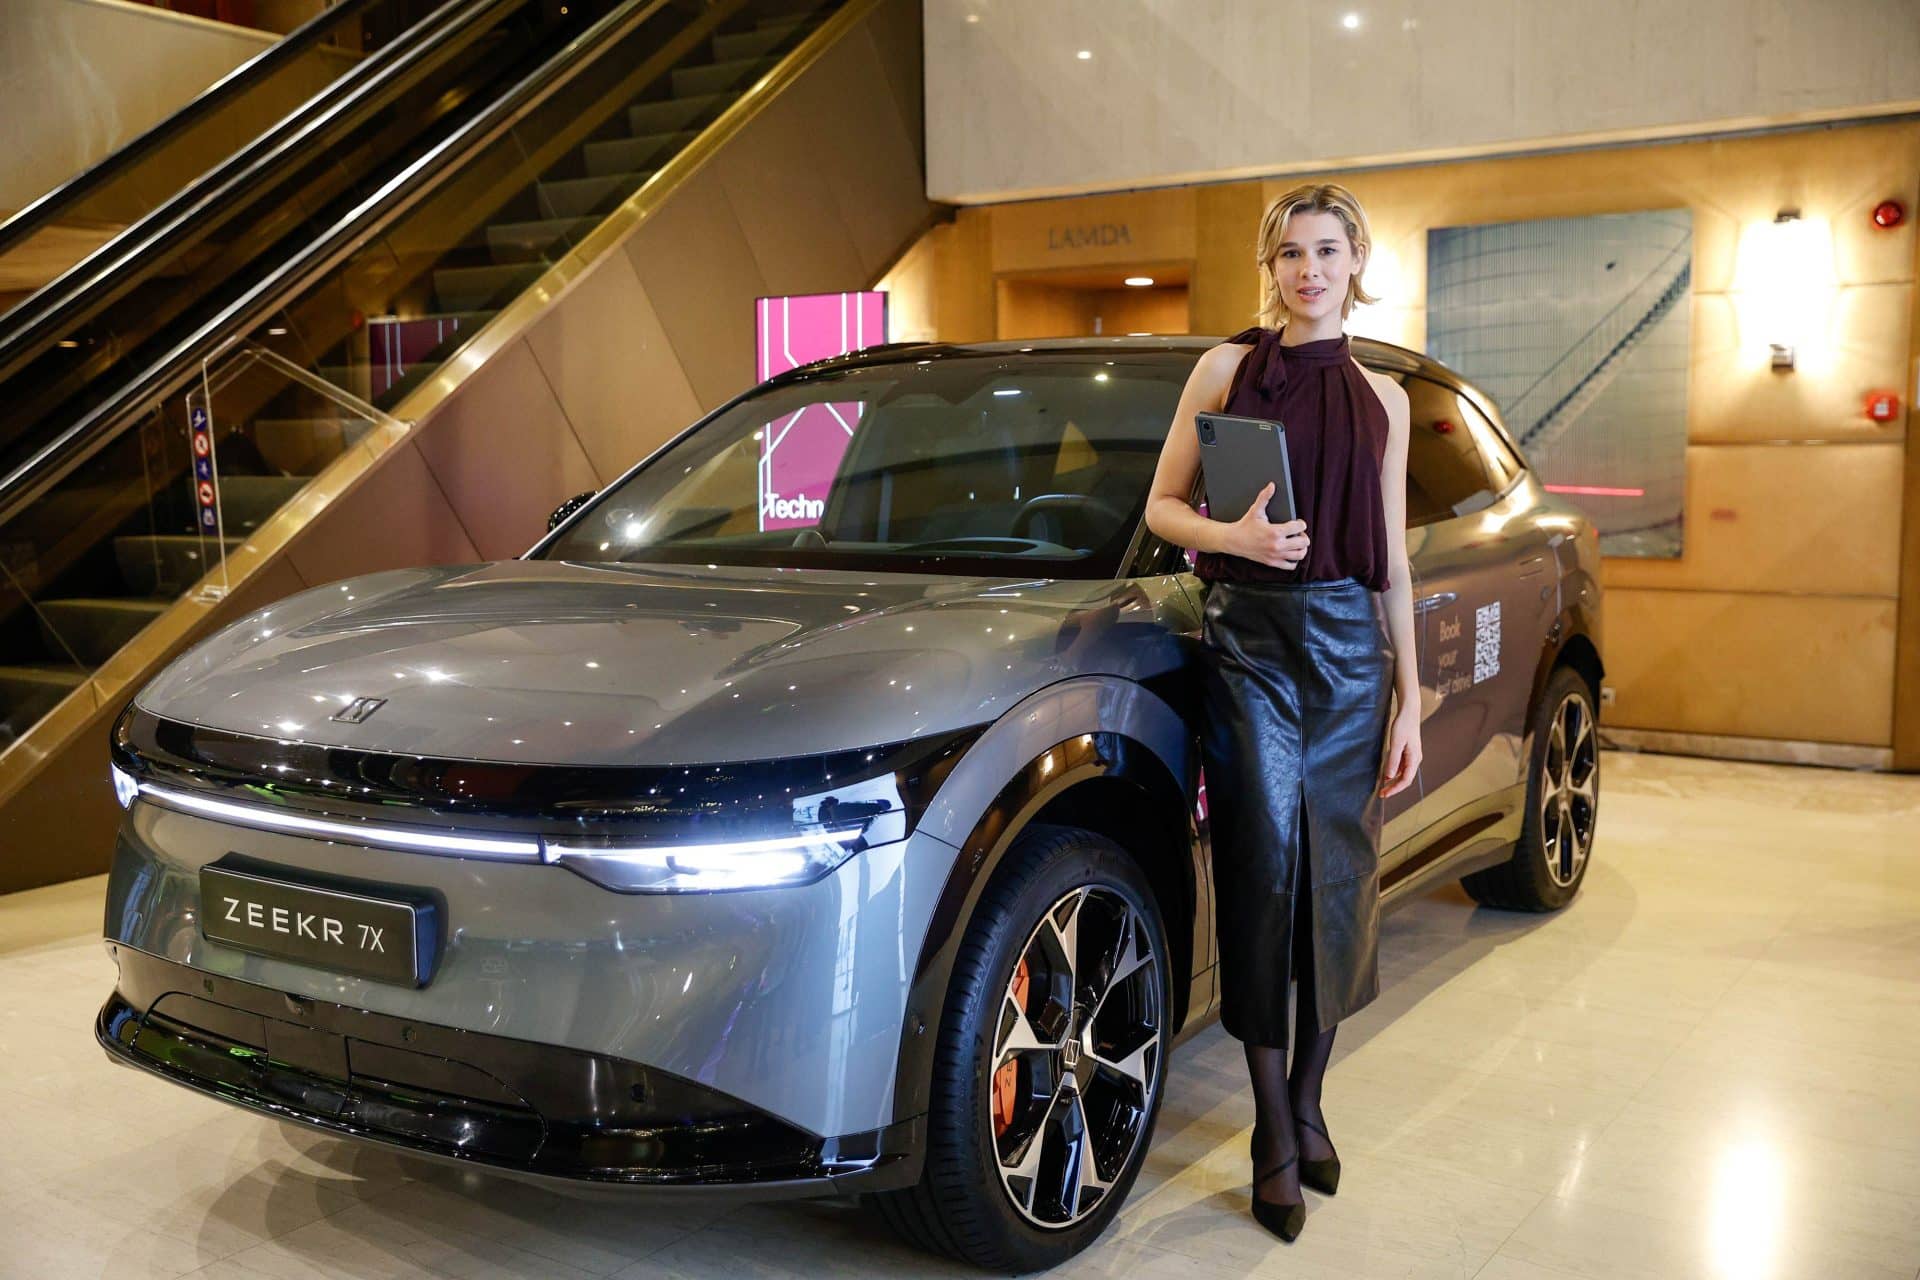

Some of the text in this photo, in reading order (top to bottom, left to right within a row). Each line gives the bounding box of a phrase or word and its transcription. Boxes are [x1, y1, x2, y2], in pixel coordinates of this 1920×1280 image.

[1048, 224, 1133, 250] LAMDA
[1440, 615, 1461, 642] Book
[1438, 649, 1458, 676] your
[223, 897, 385, 953] ZEEKR 7X
